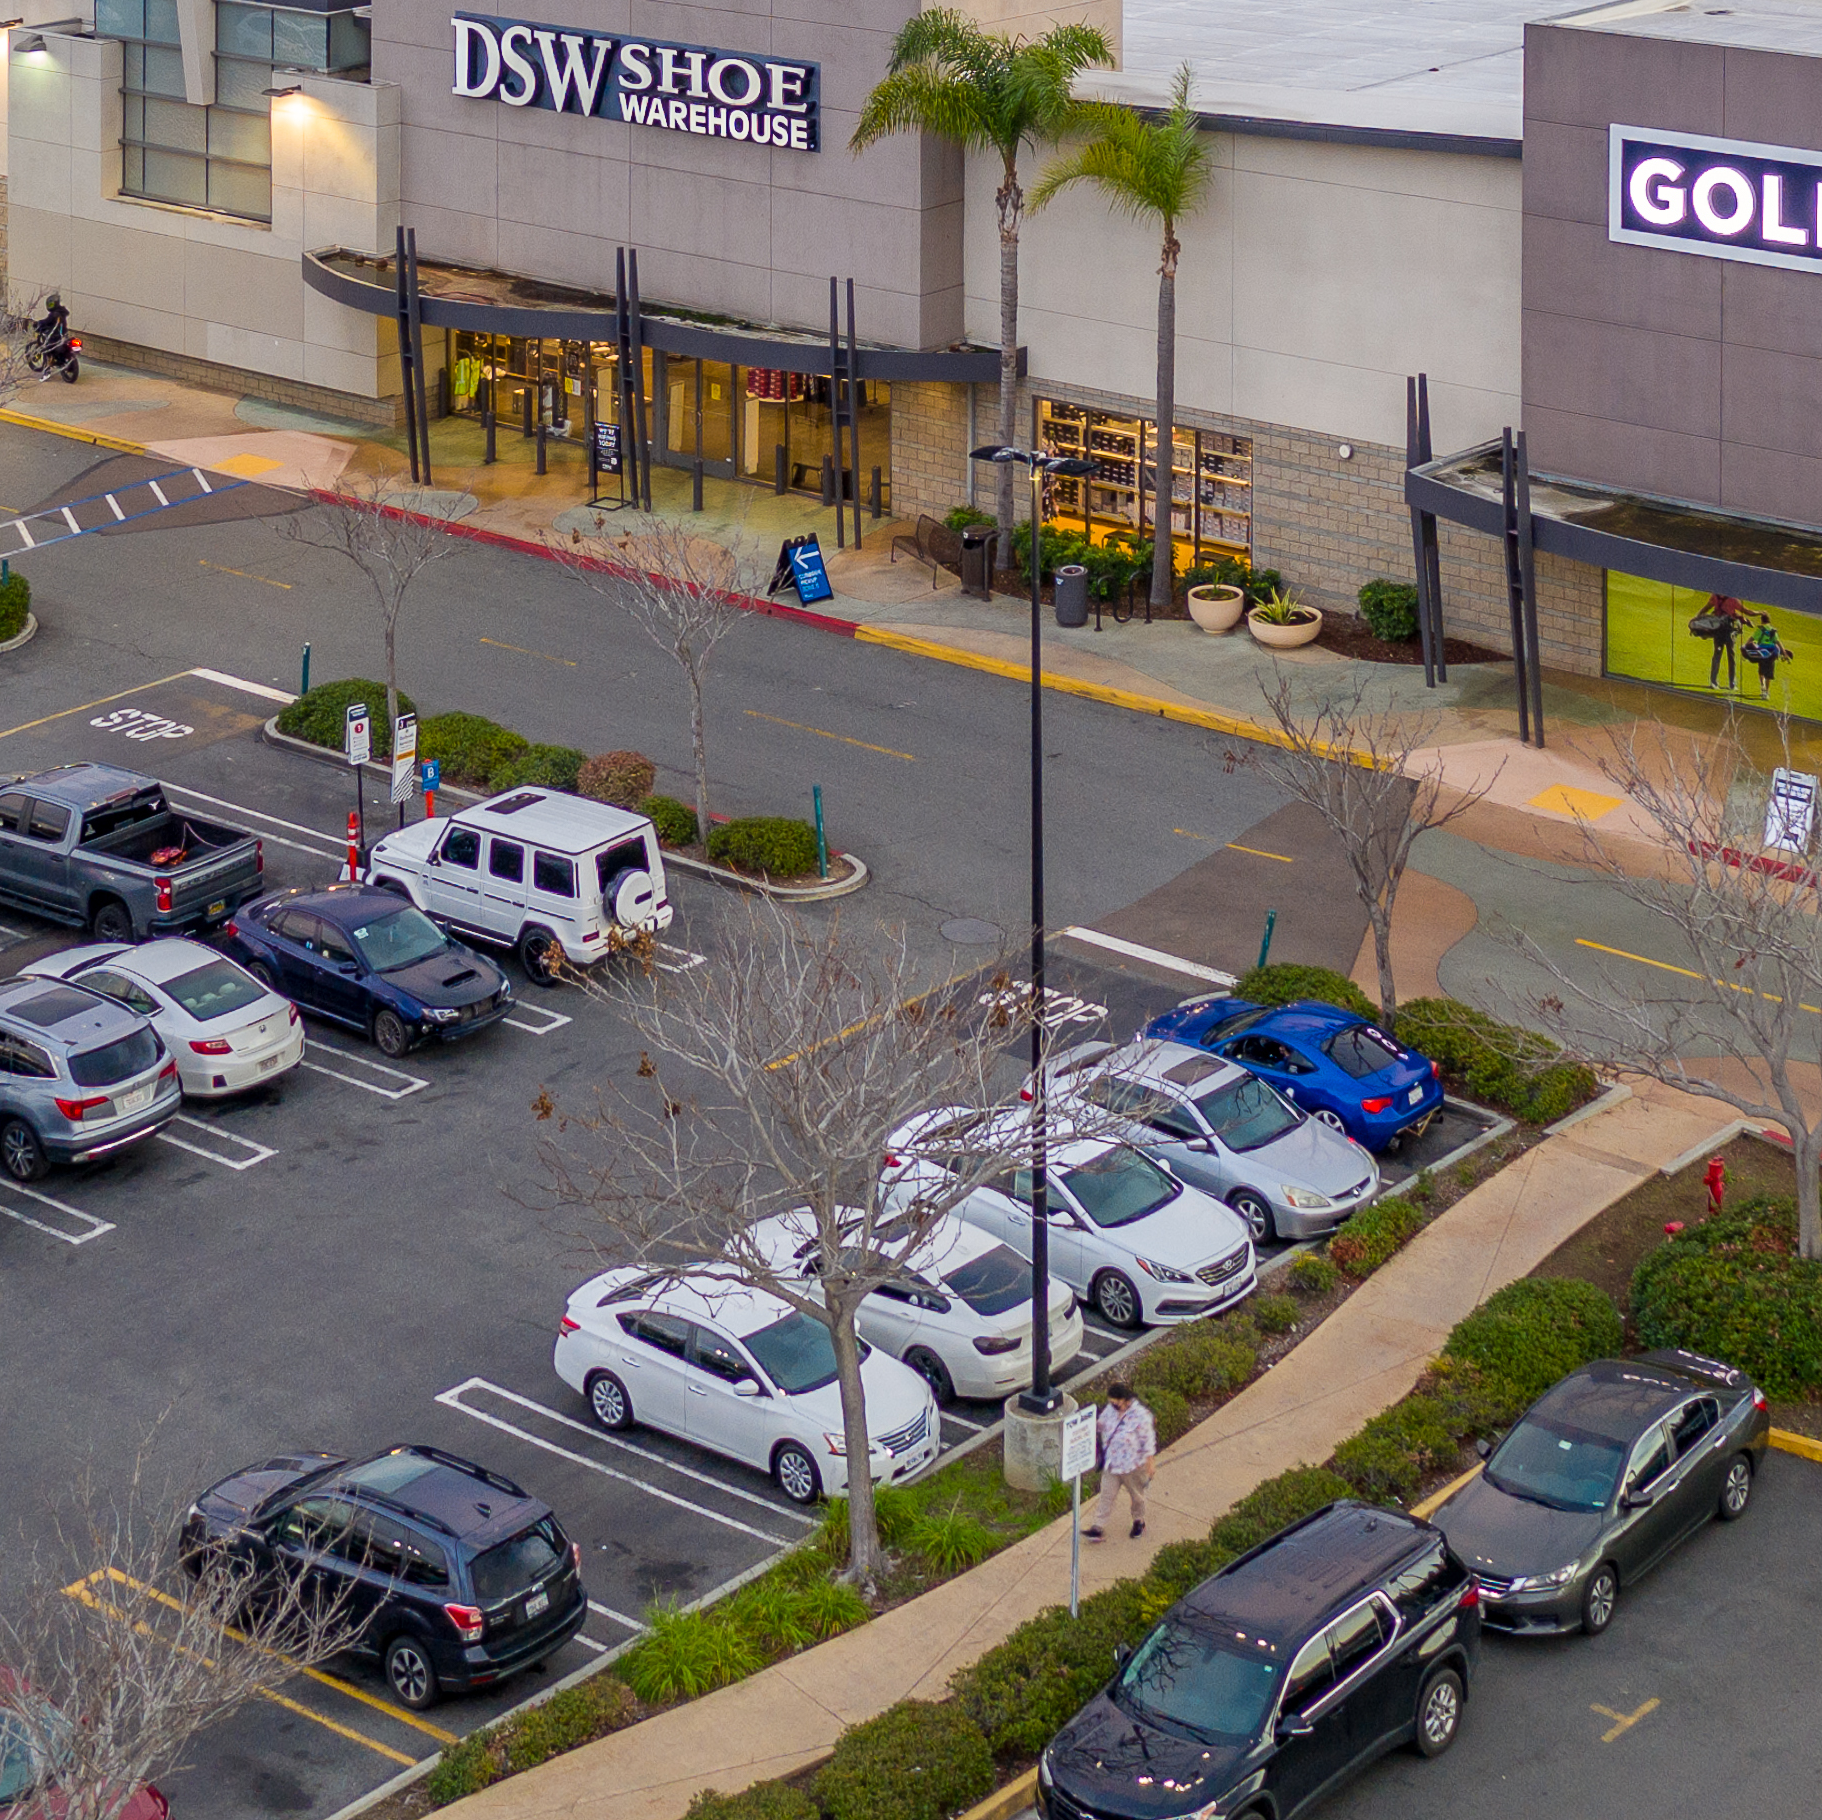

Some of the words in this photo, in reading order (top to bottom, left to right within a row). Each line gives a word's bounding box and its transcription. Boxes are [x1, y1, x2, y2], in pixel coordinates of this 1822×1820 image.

[450, 16, 611, 117] DSW
[618, 43, 808, 114] SHOE
[618, 92, 808, 150] WAREHOUSE
[90, 708, 195, 742] STOP
[427, 766, 435, 778] B
